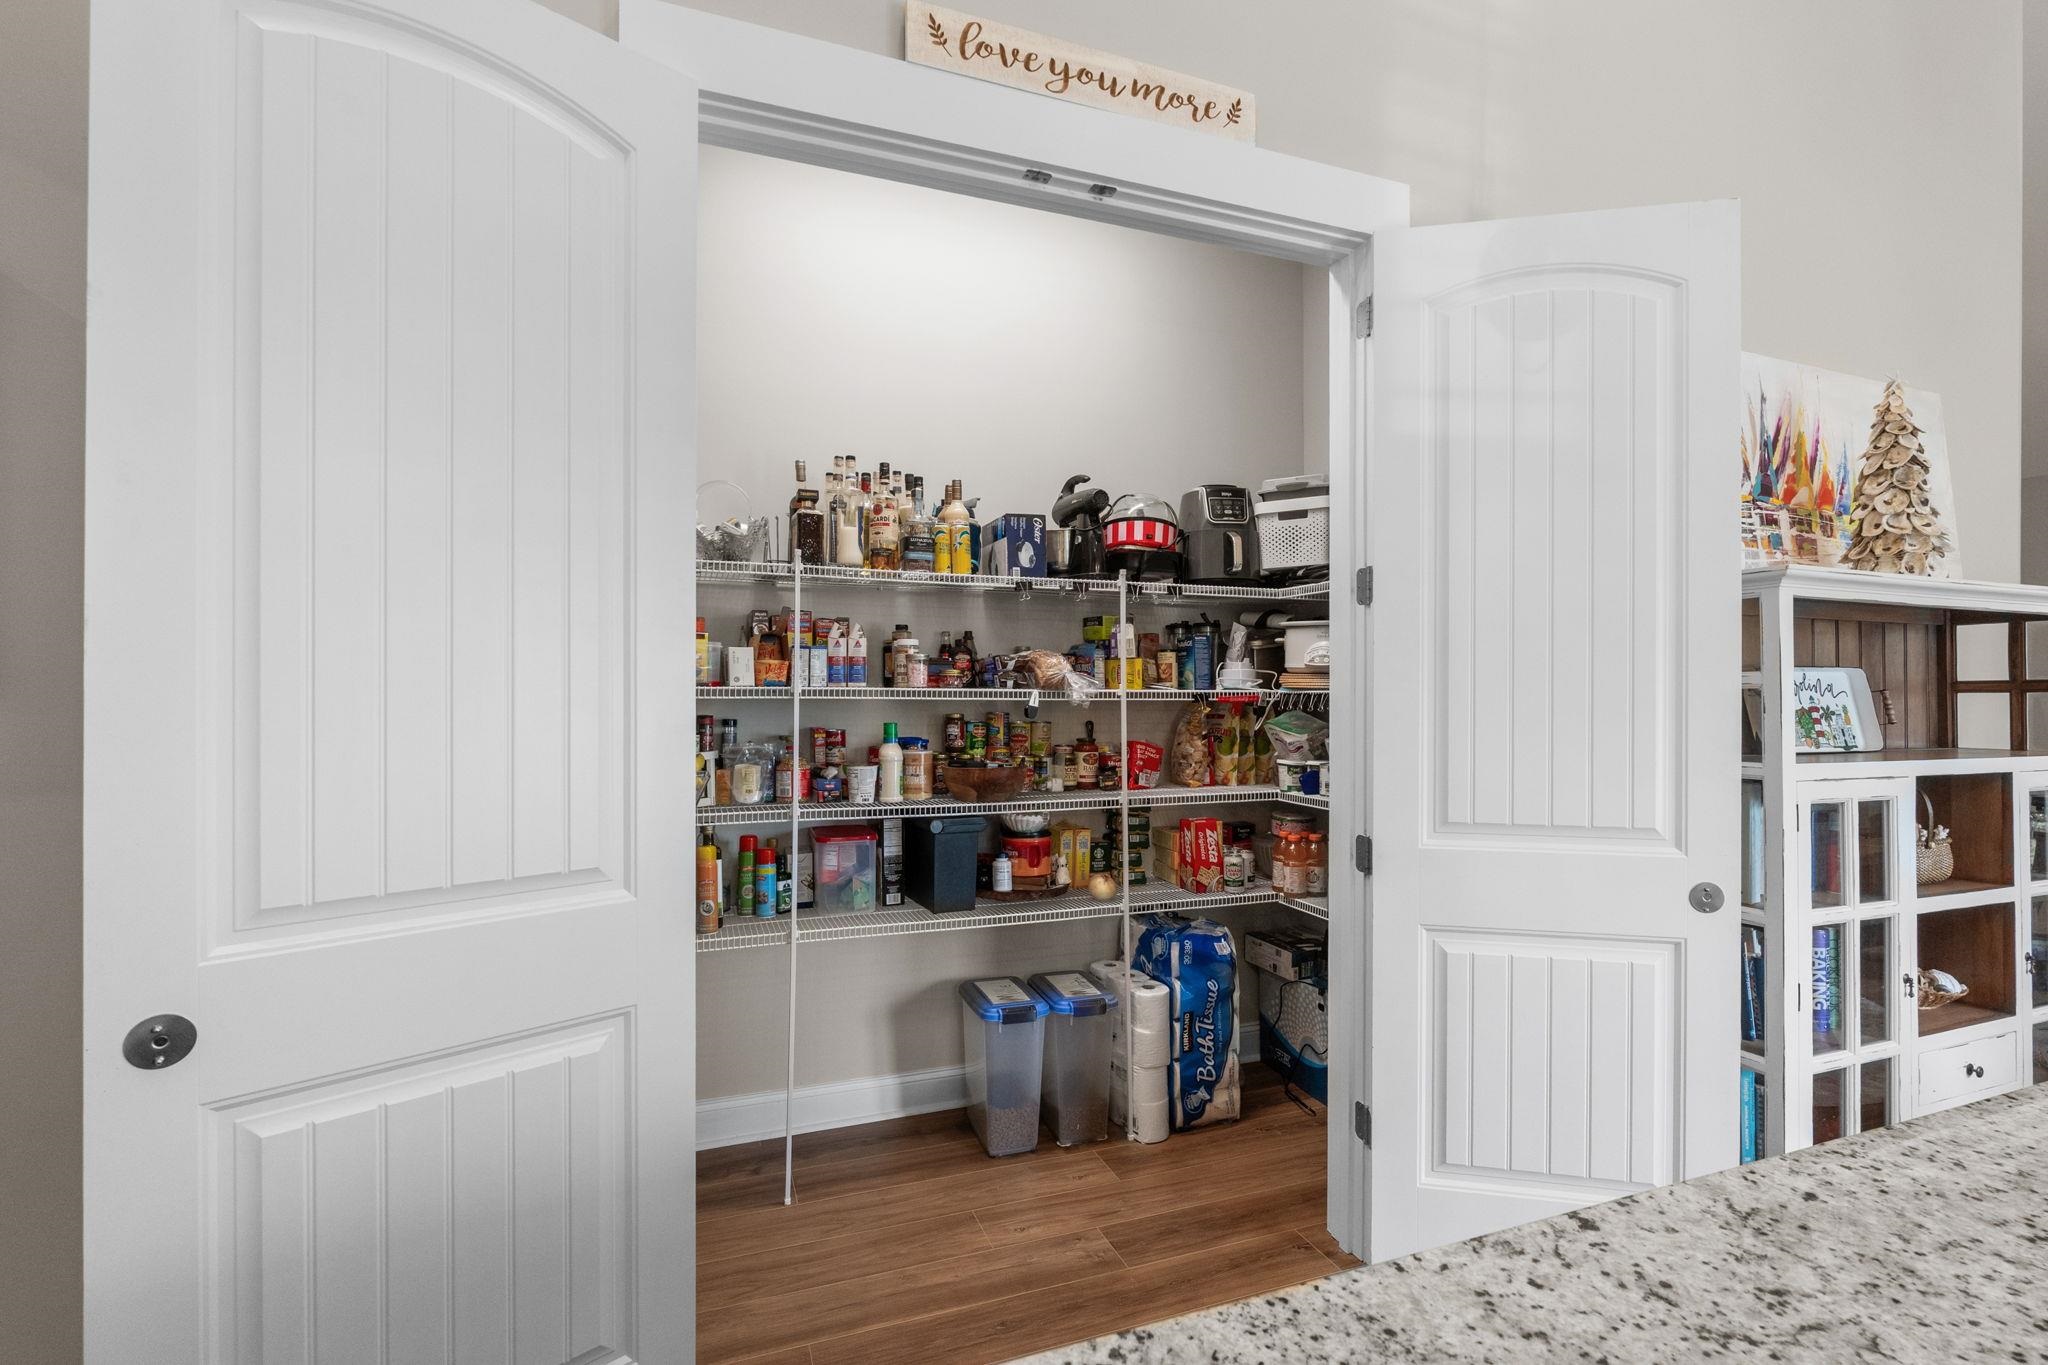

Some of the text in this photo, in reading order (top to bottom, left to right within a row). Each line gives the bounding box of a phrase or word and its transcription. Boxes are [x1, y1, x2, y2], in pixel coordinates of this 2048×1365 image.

[959, 21, 1221, 122] love you more
[1033, 518, 1042, 544] Oster
[1206, 828, 1218, 863] Zesta
[1812, 947, 1826, 1010] BAKING
[1195, 979, 1219, 1082] Bath Tissue
